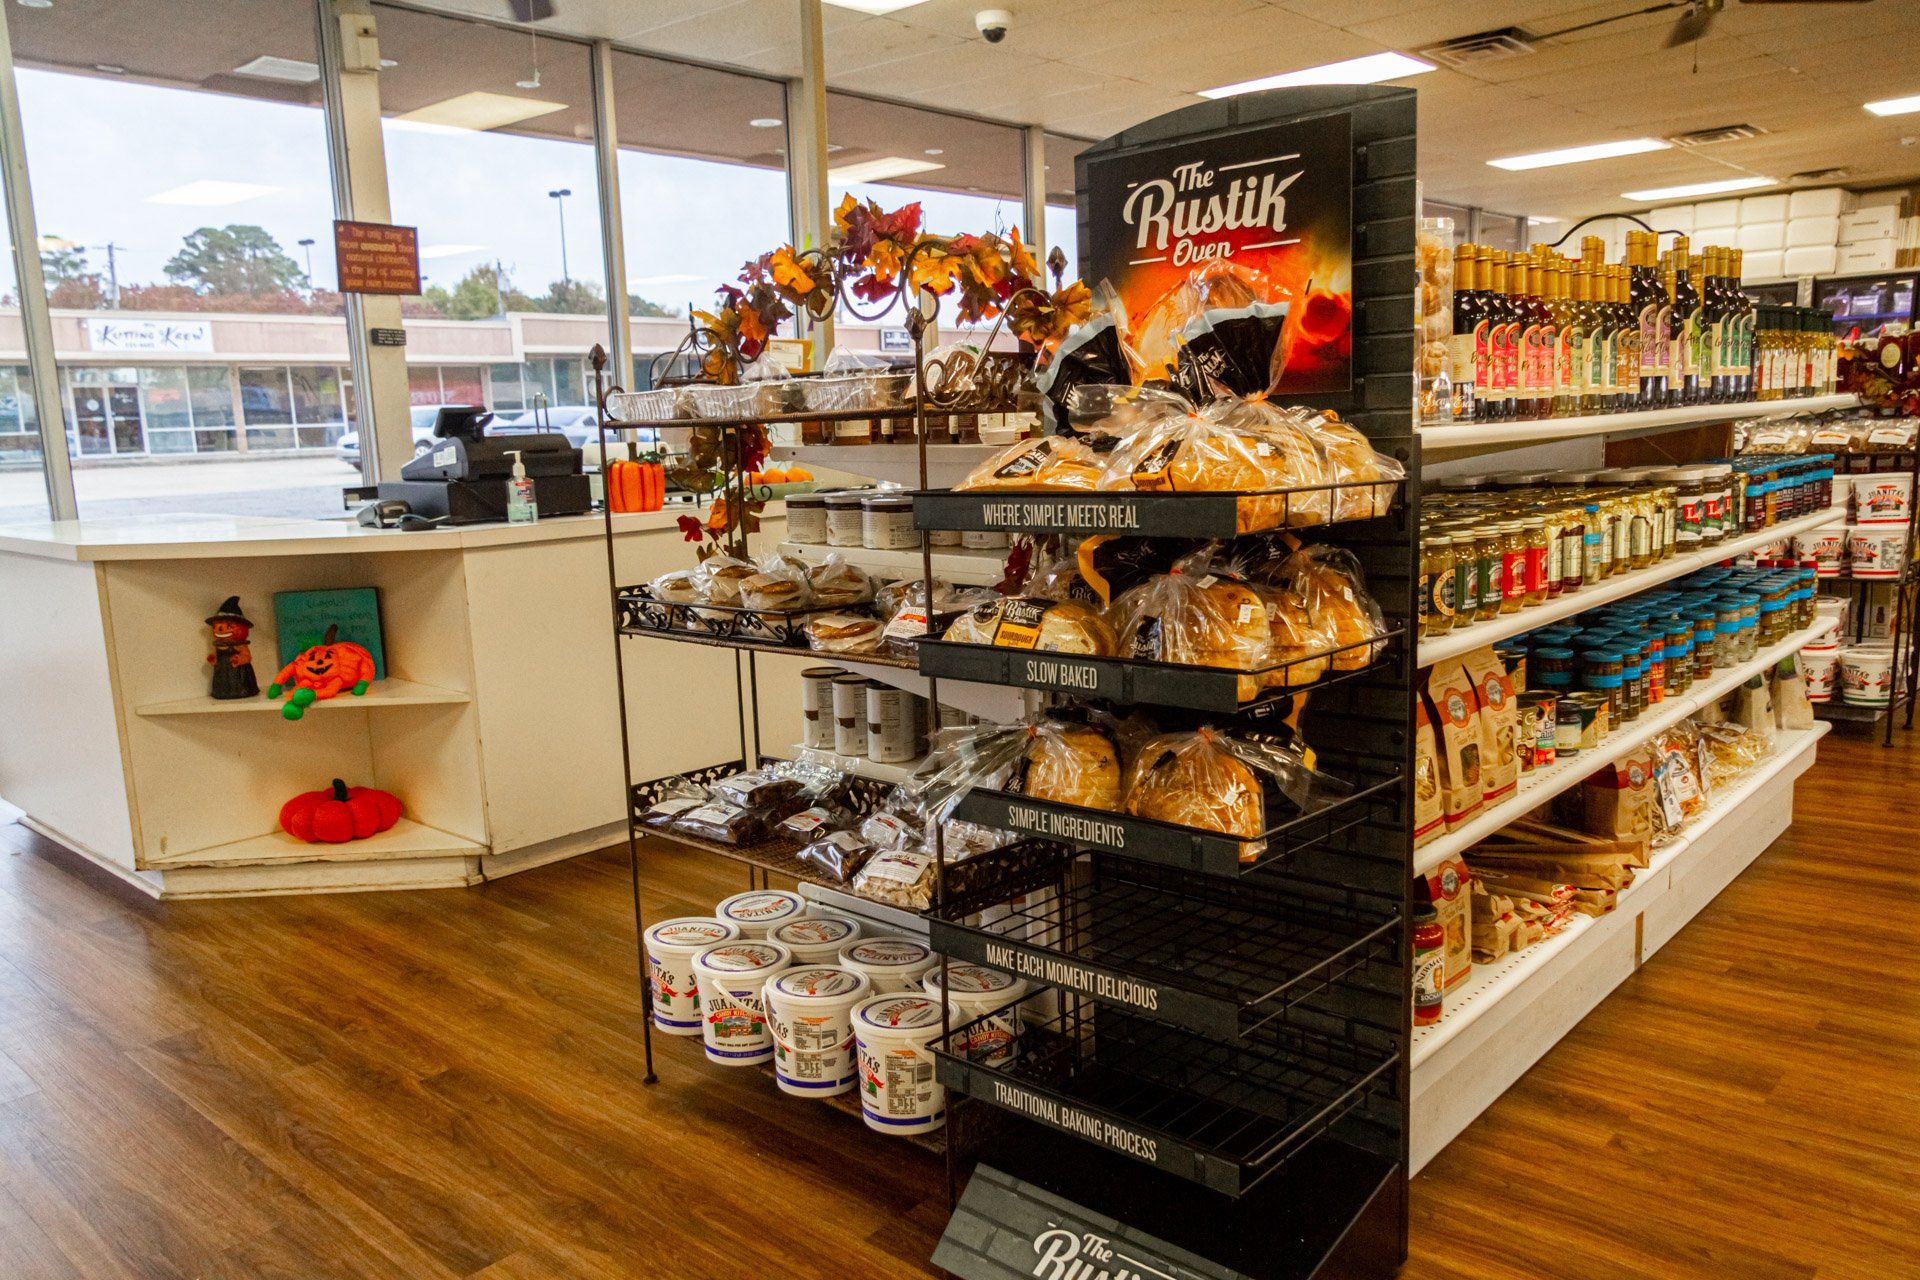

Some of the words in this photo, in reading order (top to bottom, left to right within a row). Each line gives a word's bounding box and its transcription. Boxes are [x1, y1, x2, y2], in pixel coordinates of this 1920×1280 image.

[1173, 160, 1214, 192] The
[1173, 238, 1235, 267] Oven
[983, 504, 1021, 526] WHERE
[1023, 504, 1064, 527] SIMPLE
[1067, 505, 1106, 528] MEETS
[1109, 505, 1140, 529] REAL
[1027, 660, 1057, 684] SLOW
[1060, 664, 1098, 690] BAKED
[1009, 805, 1048, 833] SIMPLE
[1050, 813, 1125, 849] INGREDIENTS
[986, 943, 1015, 971] MAKE
[1016, 952, 1044, 978] EACH
[1046, 960, 1095, 993] MOMENT
[1097, 974, 1158, 1011] DELICIOUS
[994, 1081, 1060, 1125] TRADITIONAL
[1061, 1106, 1102, 1141] BAKING
[1104, 1123, 1157, 1162] PROCESS
[1082, 1233, 1113, 1263] The
